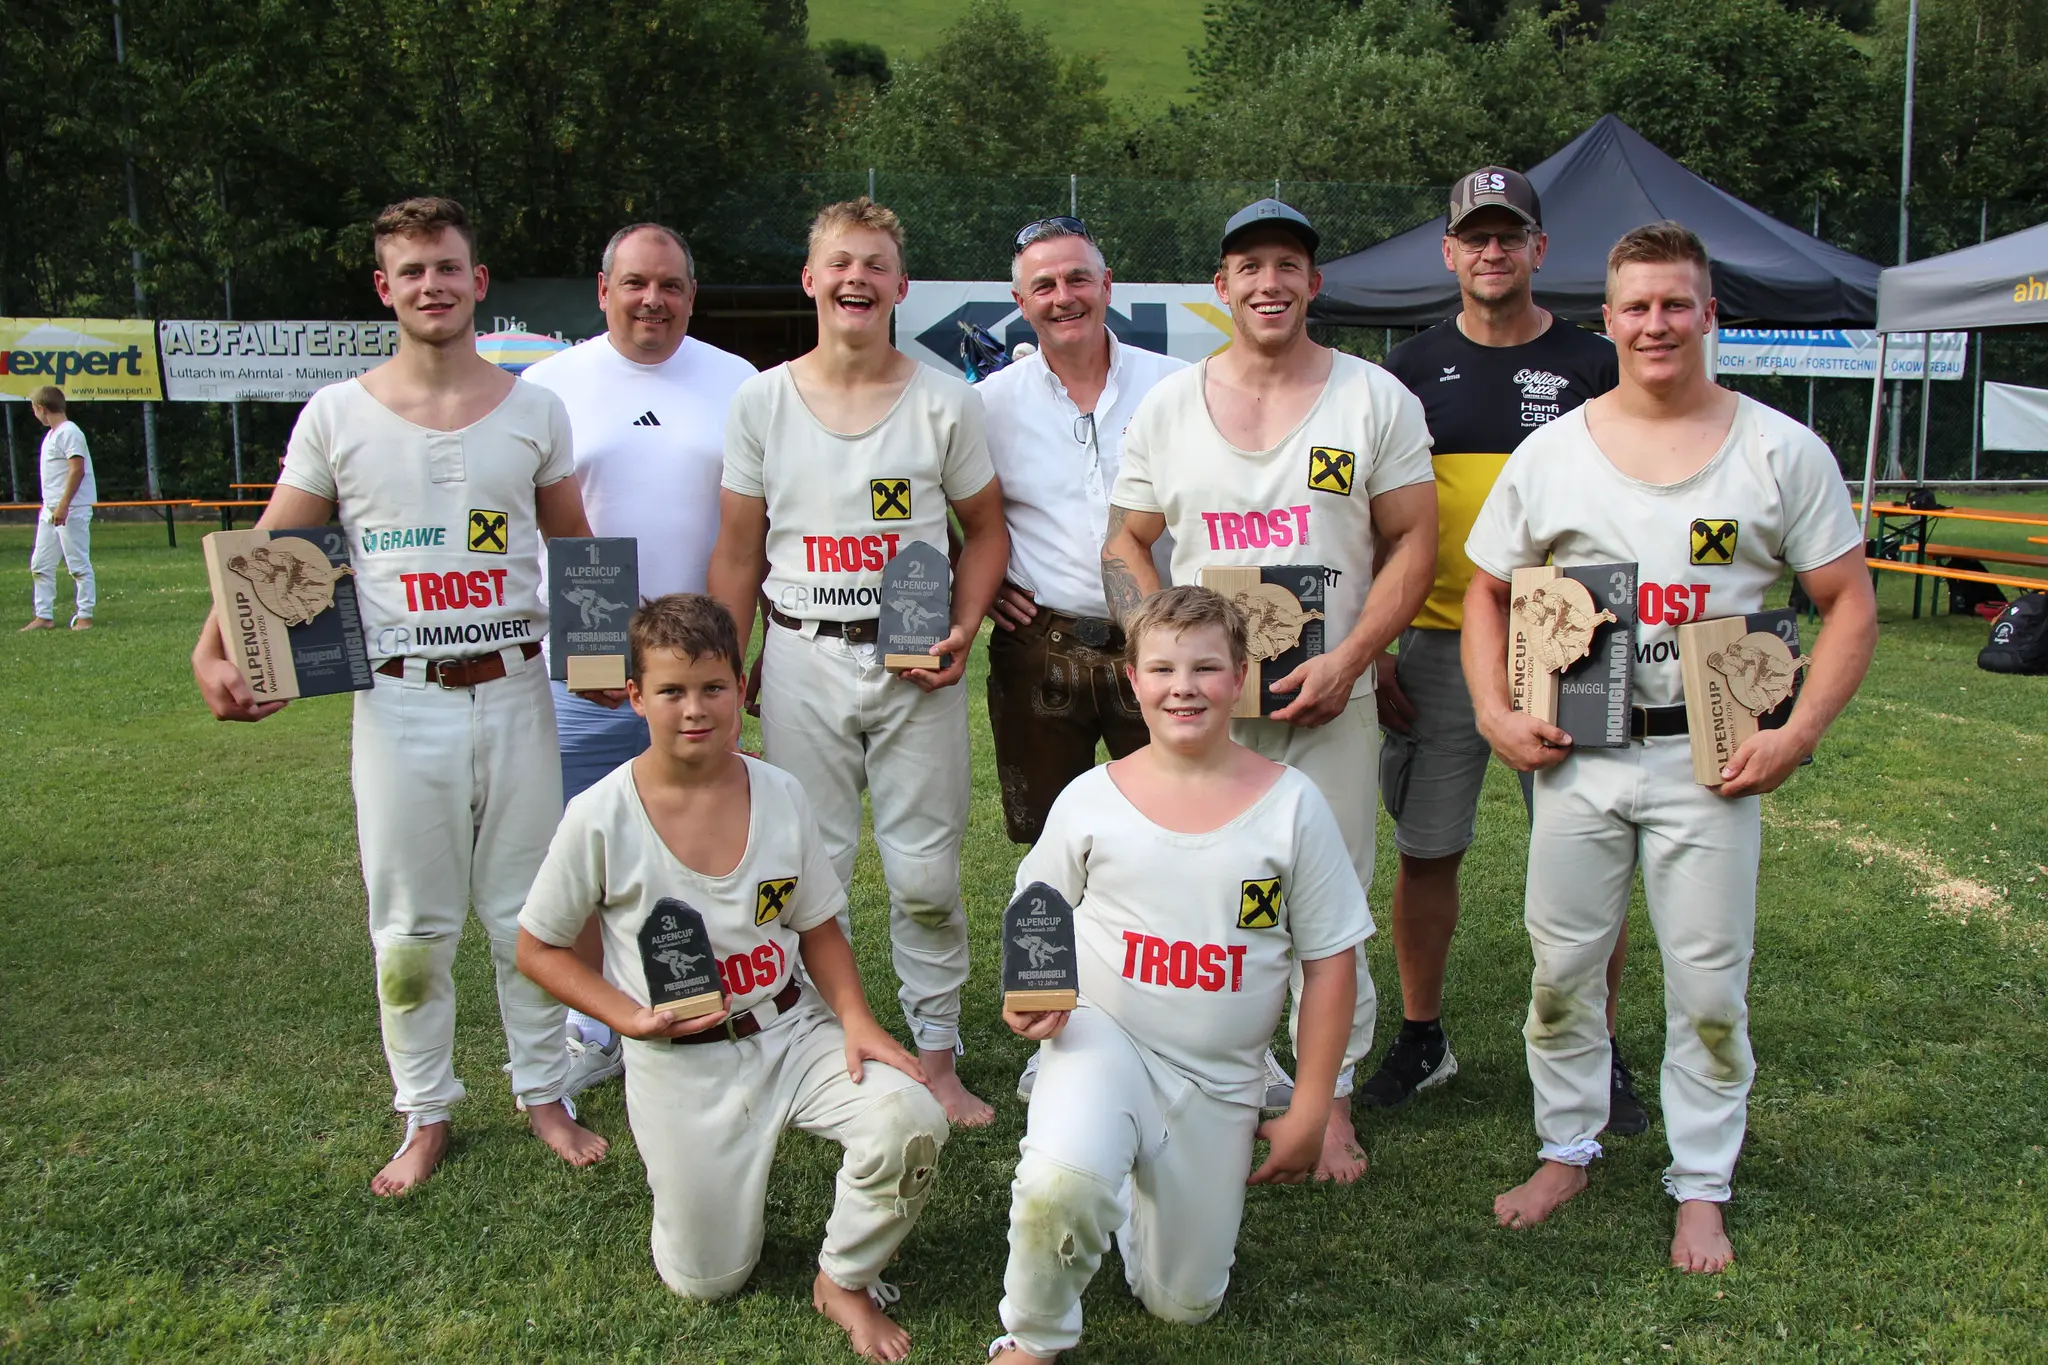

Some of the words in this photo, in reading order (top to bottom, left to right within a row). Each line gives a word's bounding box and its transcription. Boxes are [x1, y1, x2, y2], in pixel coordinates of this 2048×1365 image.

[1474, 173, 1505, 191] ES
[169, 367, 216, 379] Luttach
[220, 368, 234, 379] im
[238, 367, 283, 379] Ahrntal
[296, 367, 343, 379] Mühlen
[346, 368, 357, 379] in
[1756, 357, 1797, 368] TIEFBAU
[1806, 358, 1877, 371] FORSTTECHNI
[1440, 374, 1460, 382] erima
[71, 387, 152, 395] www.bauexpert.it
[1521, 402, 1559, 413] Hanfi
[1521, 412, 1558, 423] CBD
[1201, 505, 1311, 550] TROST
[380, 528, 446, 551] GRAWE
[803, 534, 900, 572] TROST
[565, 567, 621, 577] ALPENCUP
[400, 569, 508, 612] TROST
[892, 580, 940, 590] ALPENCUP
[256, 615, 270, 637] 2026
[416, 620, 531, 646] IMMOWERT
[236, 592, 268, 694] ALPENCUP
[336, 585, 371, 686] HOUGLMOA
[567, 632, 626, 643] PREISRANGGELN
[263, 636, 279, 693] Weißenbach
[295, 646, 342, 665] Jugend
[1562, 683, 1607, 695] RANGGL
[1606, 630, 1629, 742] HOUGLMOA
[1726, 701, 1736, 722] 2026
[1016, 917, 1062, 927] ALPENCUP
[652, 928, 694, 945] ALPENCUP
[1122, 930, 1247, 992] TROST
[1018, 970, 1066, 980] PREISRANGGELN
